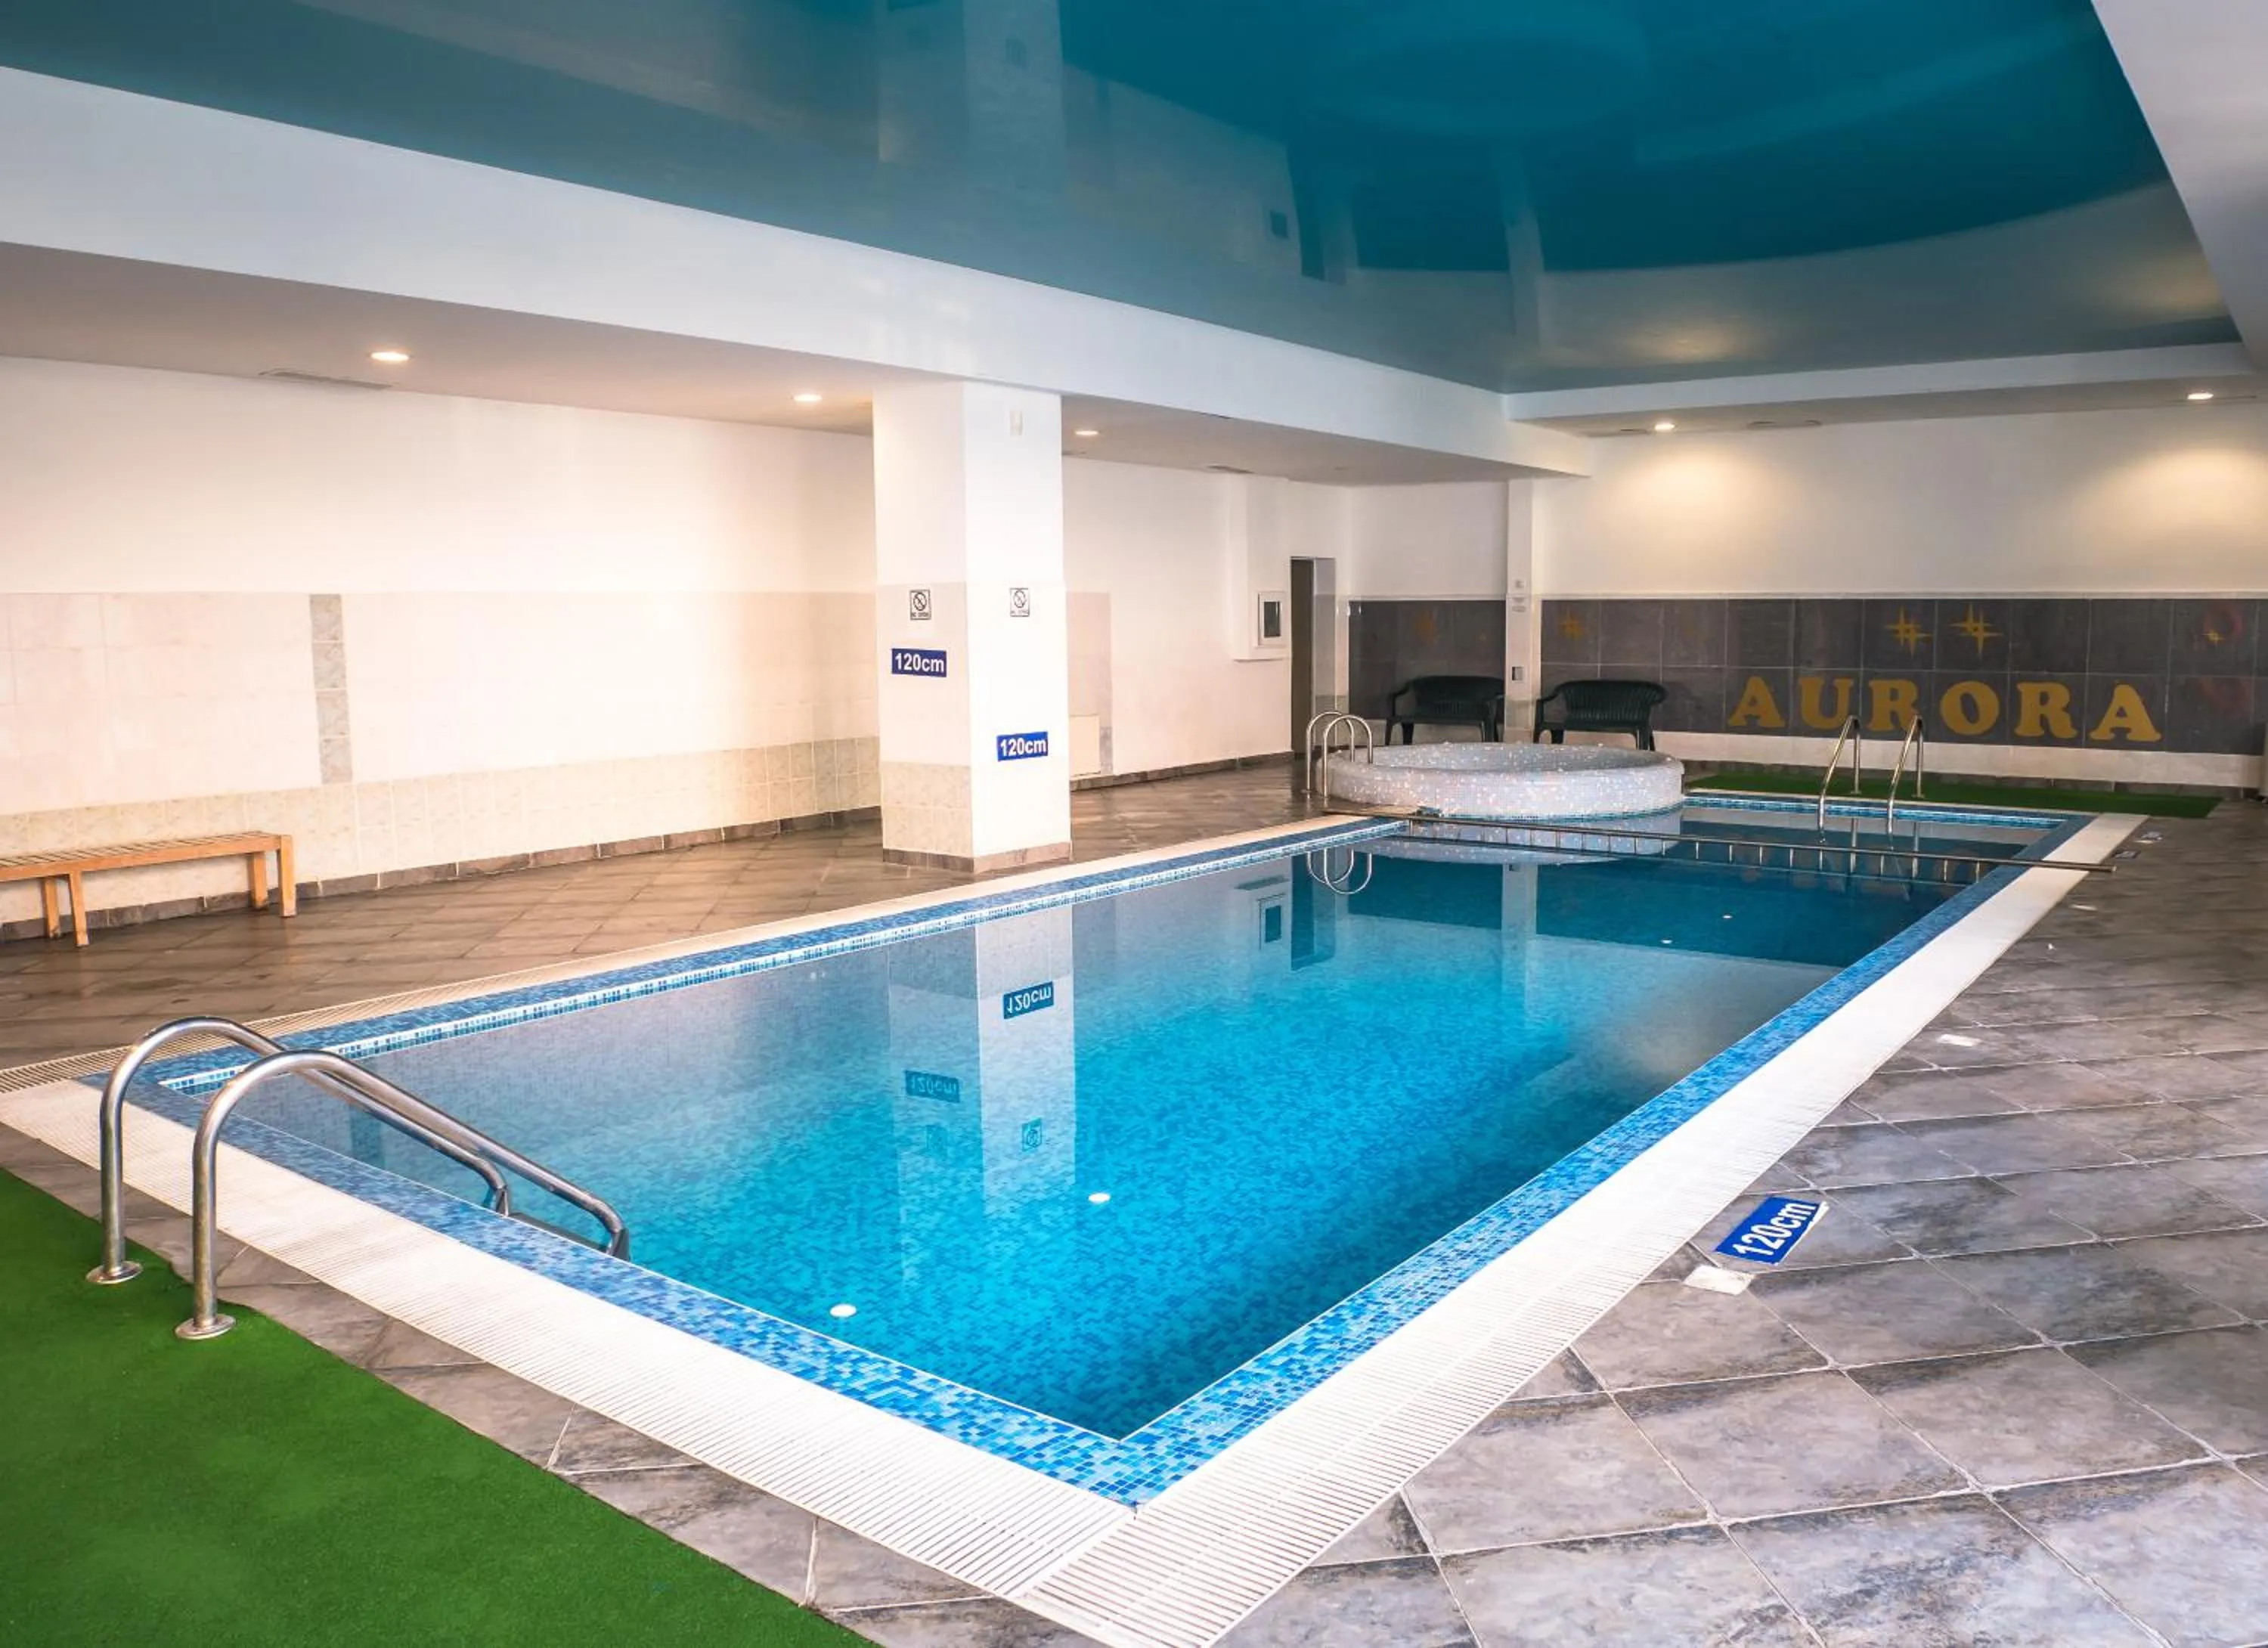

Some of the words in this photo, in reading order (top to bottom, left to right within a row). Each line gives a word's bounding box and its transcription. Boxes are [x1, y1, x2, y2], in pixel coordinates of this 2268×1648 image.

[894, 652, 944, 673] 120cm
[1728, 675, 2162, 742] AURORA
[1000, 737, 1047, 757] 120cm
[1732, 1203, 1817, 1256] 120cm
